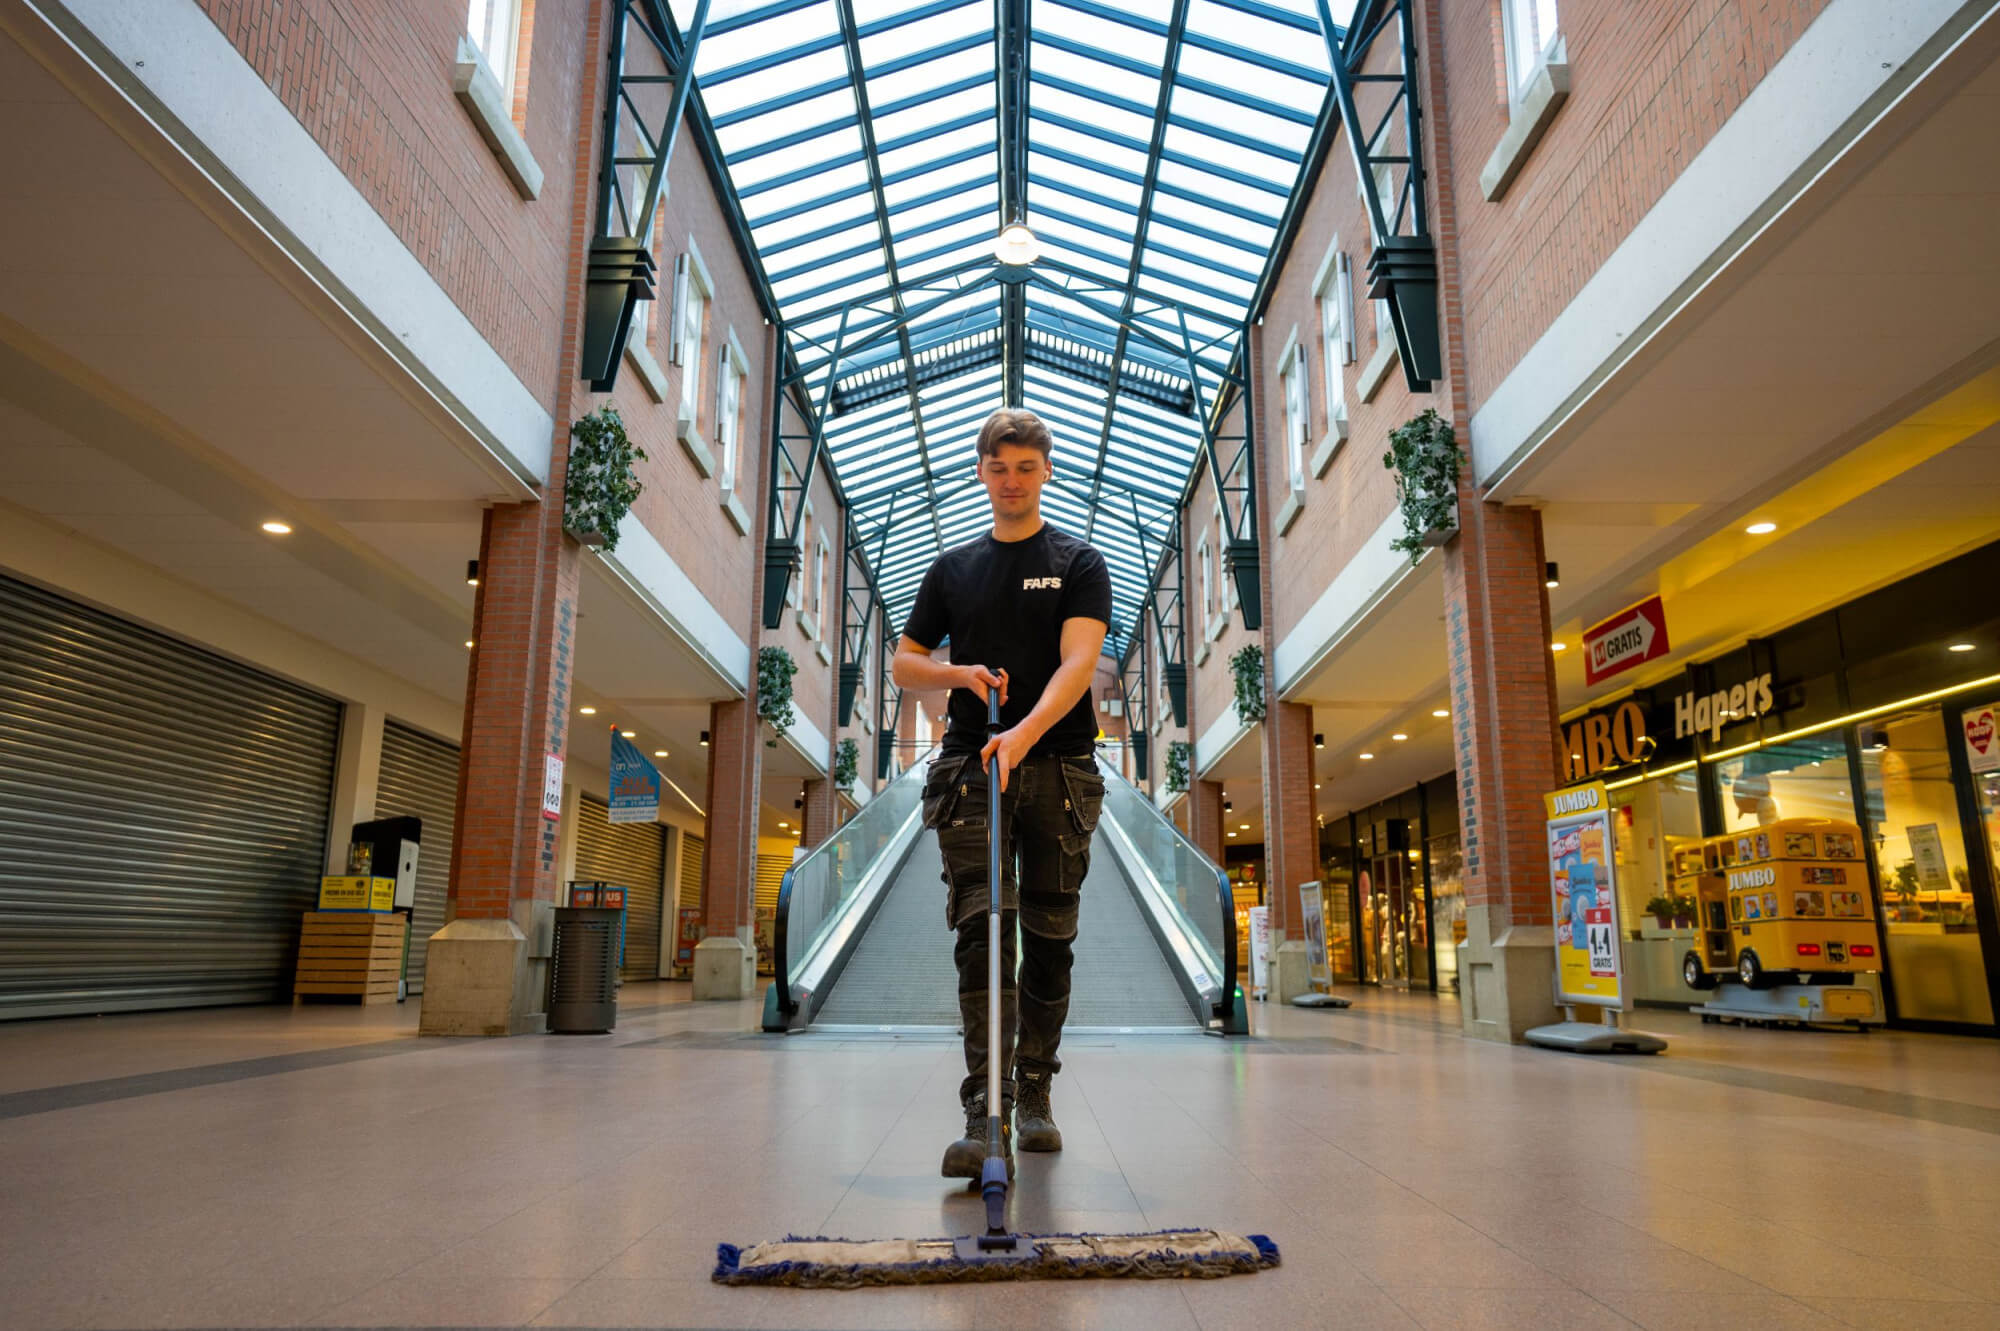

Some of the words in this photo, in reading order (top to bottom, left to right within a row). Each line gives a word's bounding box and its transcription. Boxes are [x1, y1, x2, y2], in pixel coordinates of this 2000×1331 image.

[1023, 576, 1062, 590] FAFS
[1606, 625, 1643, 659] GRATIS
[1675, 672, 1774, 743] Hapers
[1553, 788, 1599, 816] JUMBO
[1729, 867, 1775, 891] JUMBO
[586, 892, 621, 901] BUS
[1593, 957, 1613, 969] GRATIS
